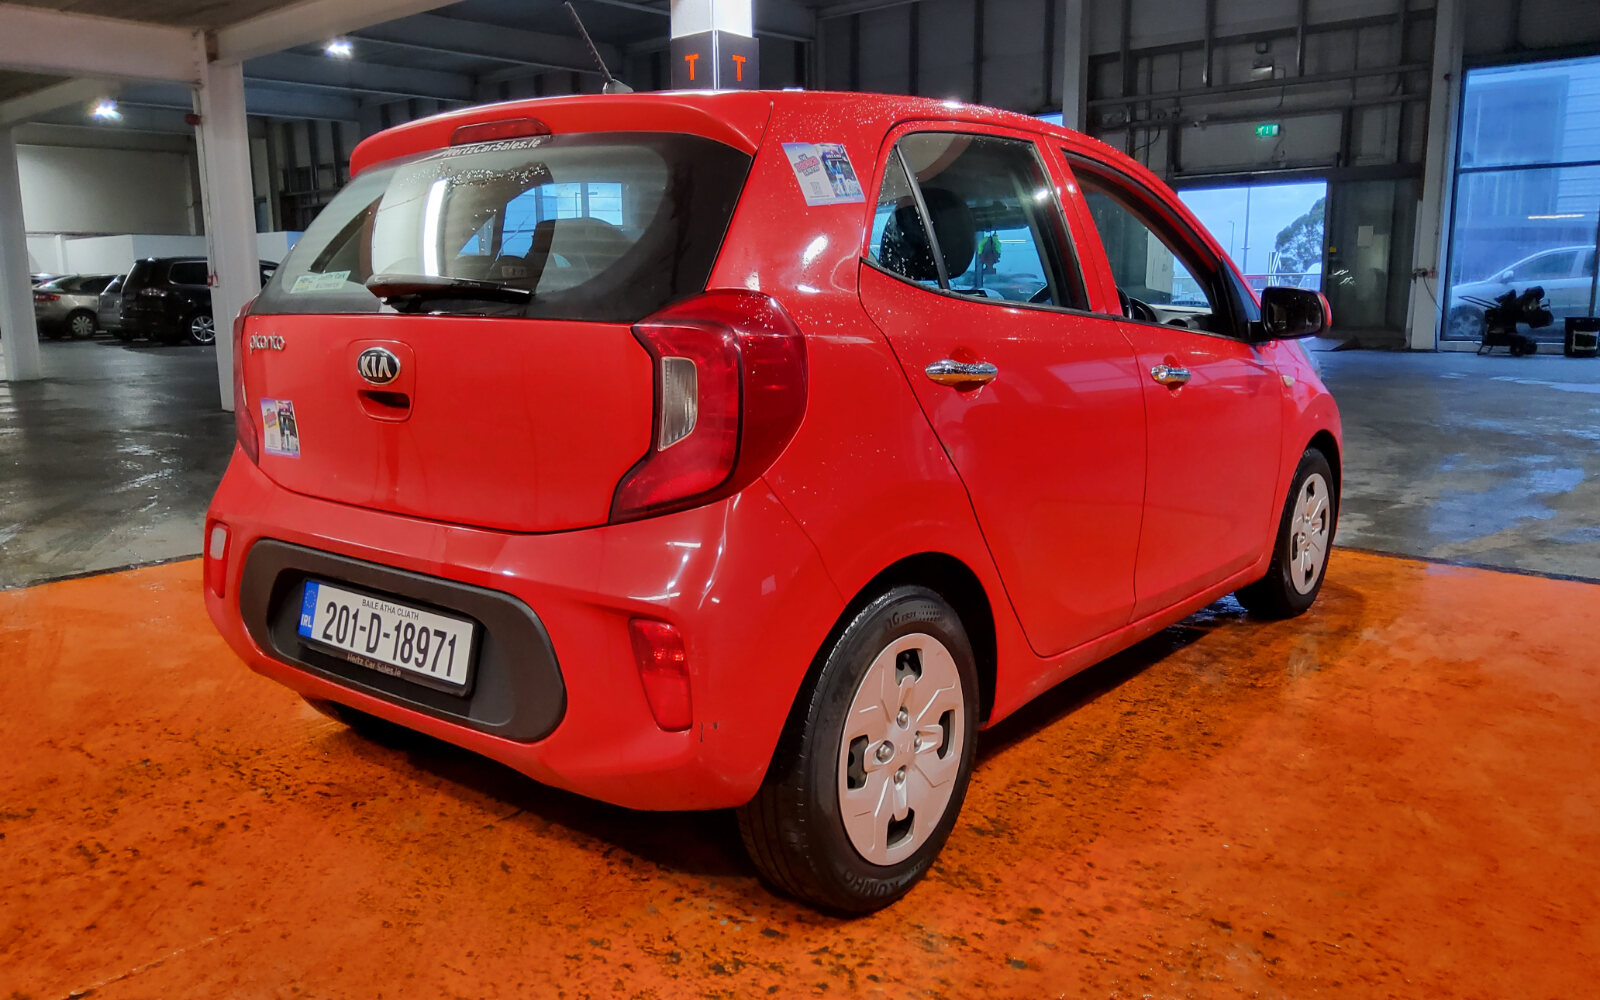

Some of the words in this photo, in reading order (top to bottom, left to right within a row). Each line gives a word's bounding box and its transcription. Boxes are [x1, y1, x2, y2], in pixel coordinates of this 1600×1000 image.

[685, 53, 699, 80] T
[732, 55, 746, 81] T
[443, 139, 540, 157] HertzCarSales.ie
[250, 331, 285, 355] picanto
[361, 357, 392, 377] KIA
[362, 599, 379, 610] BAILE
[396, 607, 419, 620] CLIATH
[300, 614, 312, 628] IRL
[322, 601, 457, 677] 201-D-18971
[347, 653, 364, 666] Hertz
[365, 659, 375, 669] Car
